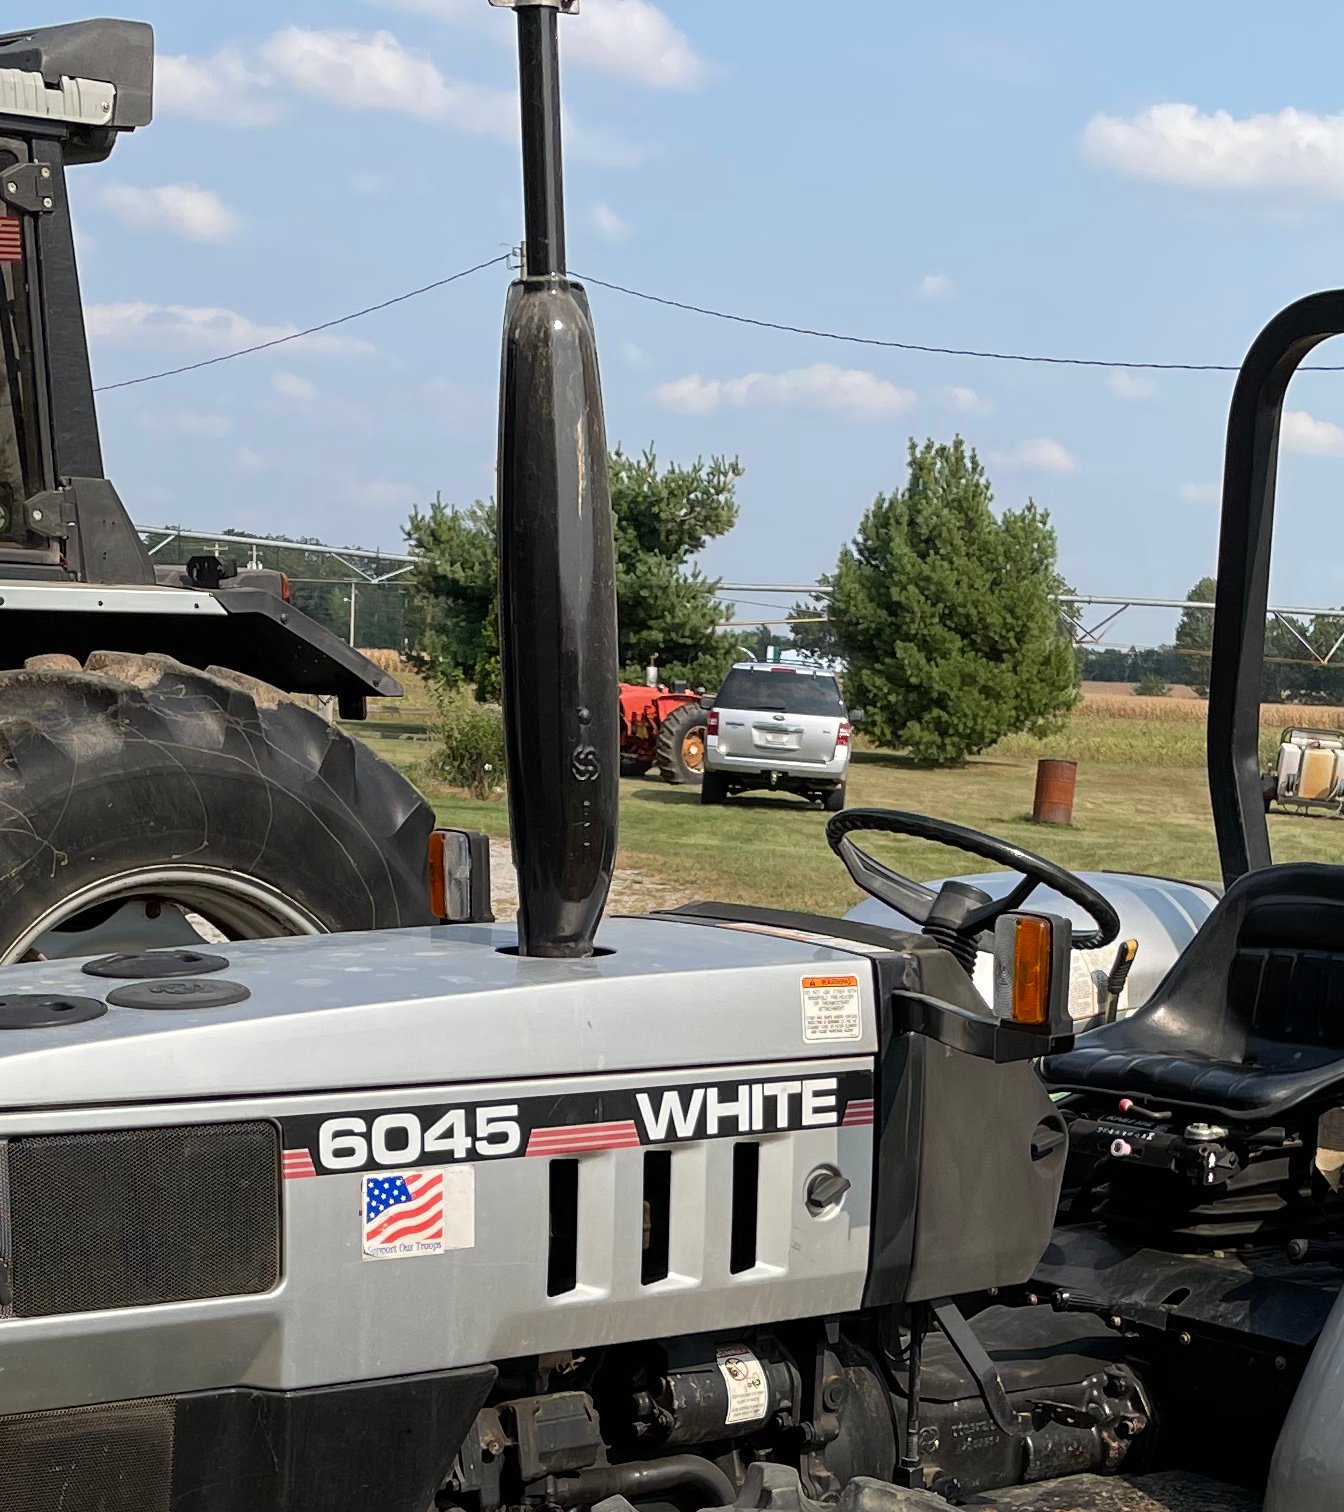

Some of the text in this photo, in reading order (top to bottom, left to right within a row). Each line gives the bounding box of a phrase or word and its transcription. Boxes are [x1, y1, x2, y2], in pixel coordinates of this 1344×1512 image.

[317, 1077, 840, 1169] 6045 WHITE
[399, 1243, 414, 1252] Our
[416, 1241, 442, 1252] Troops
